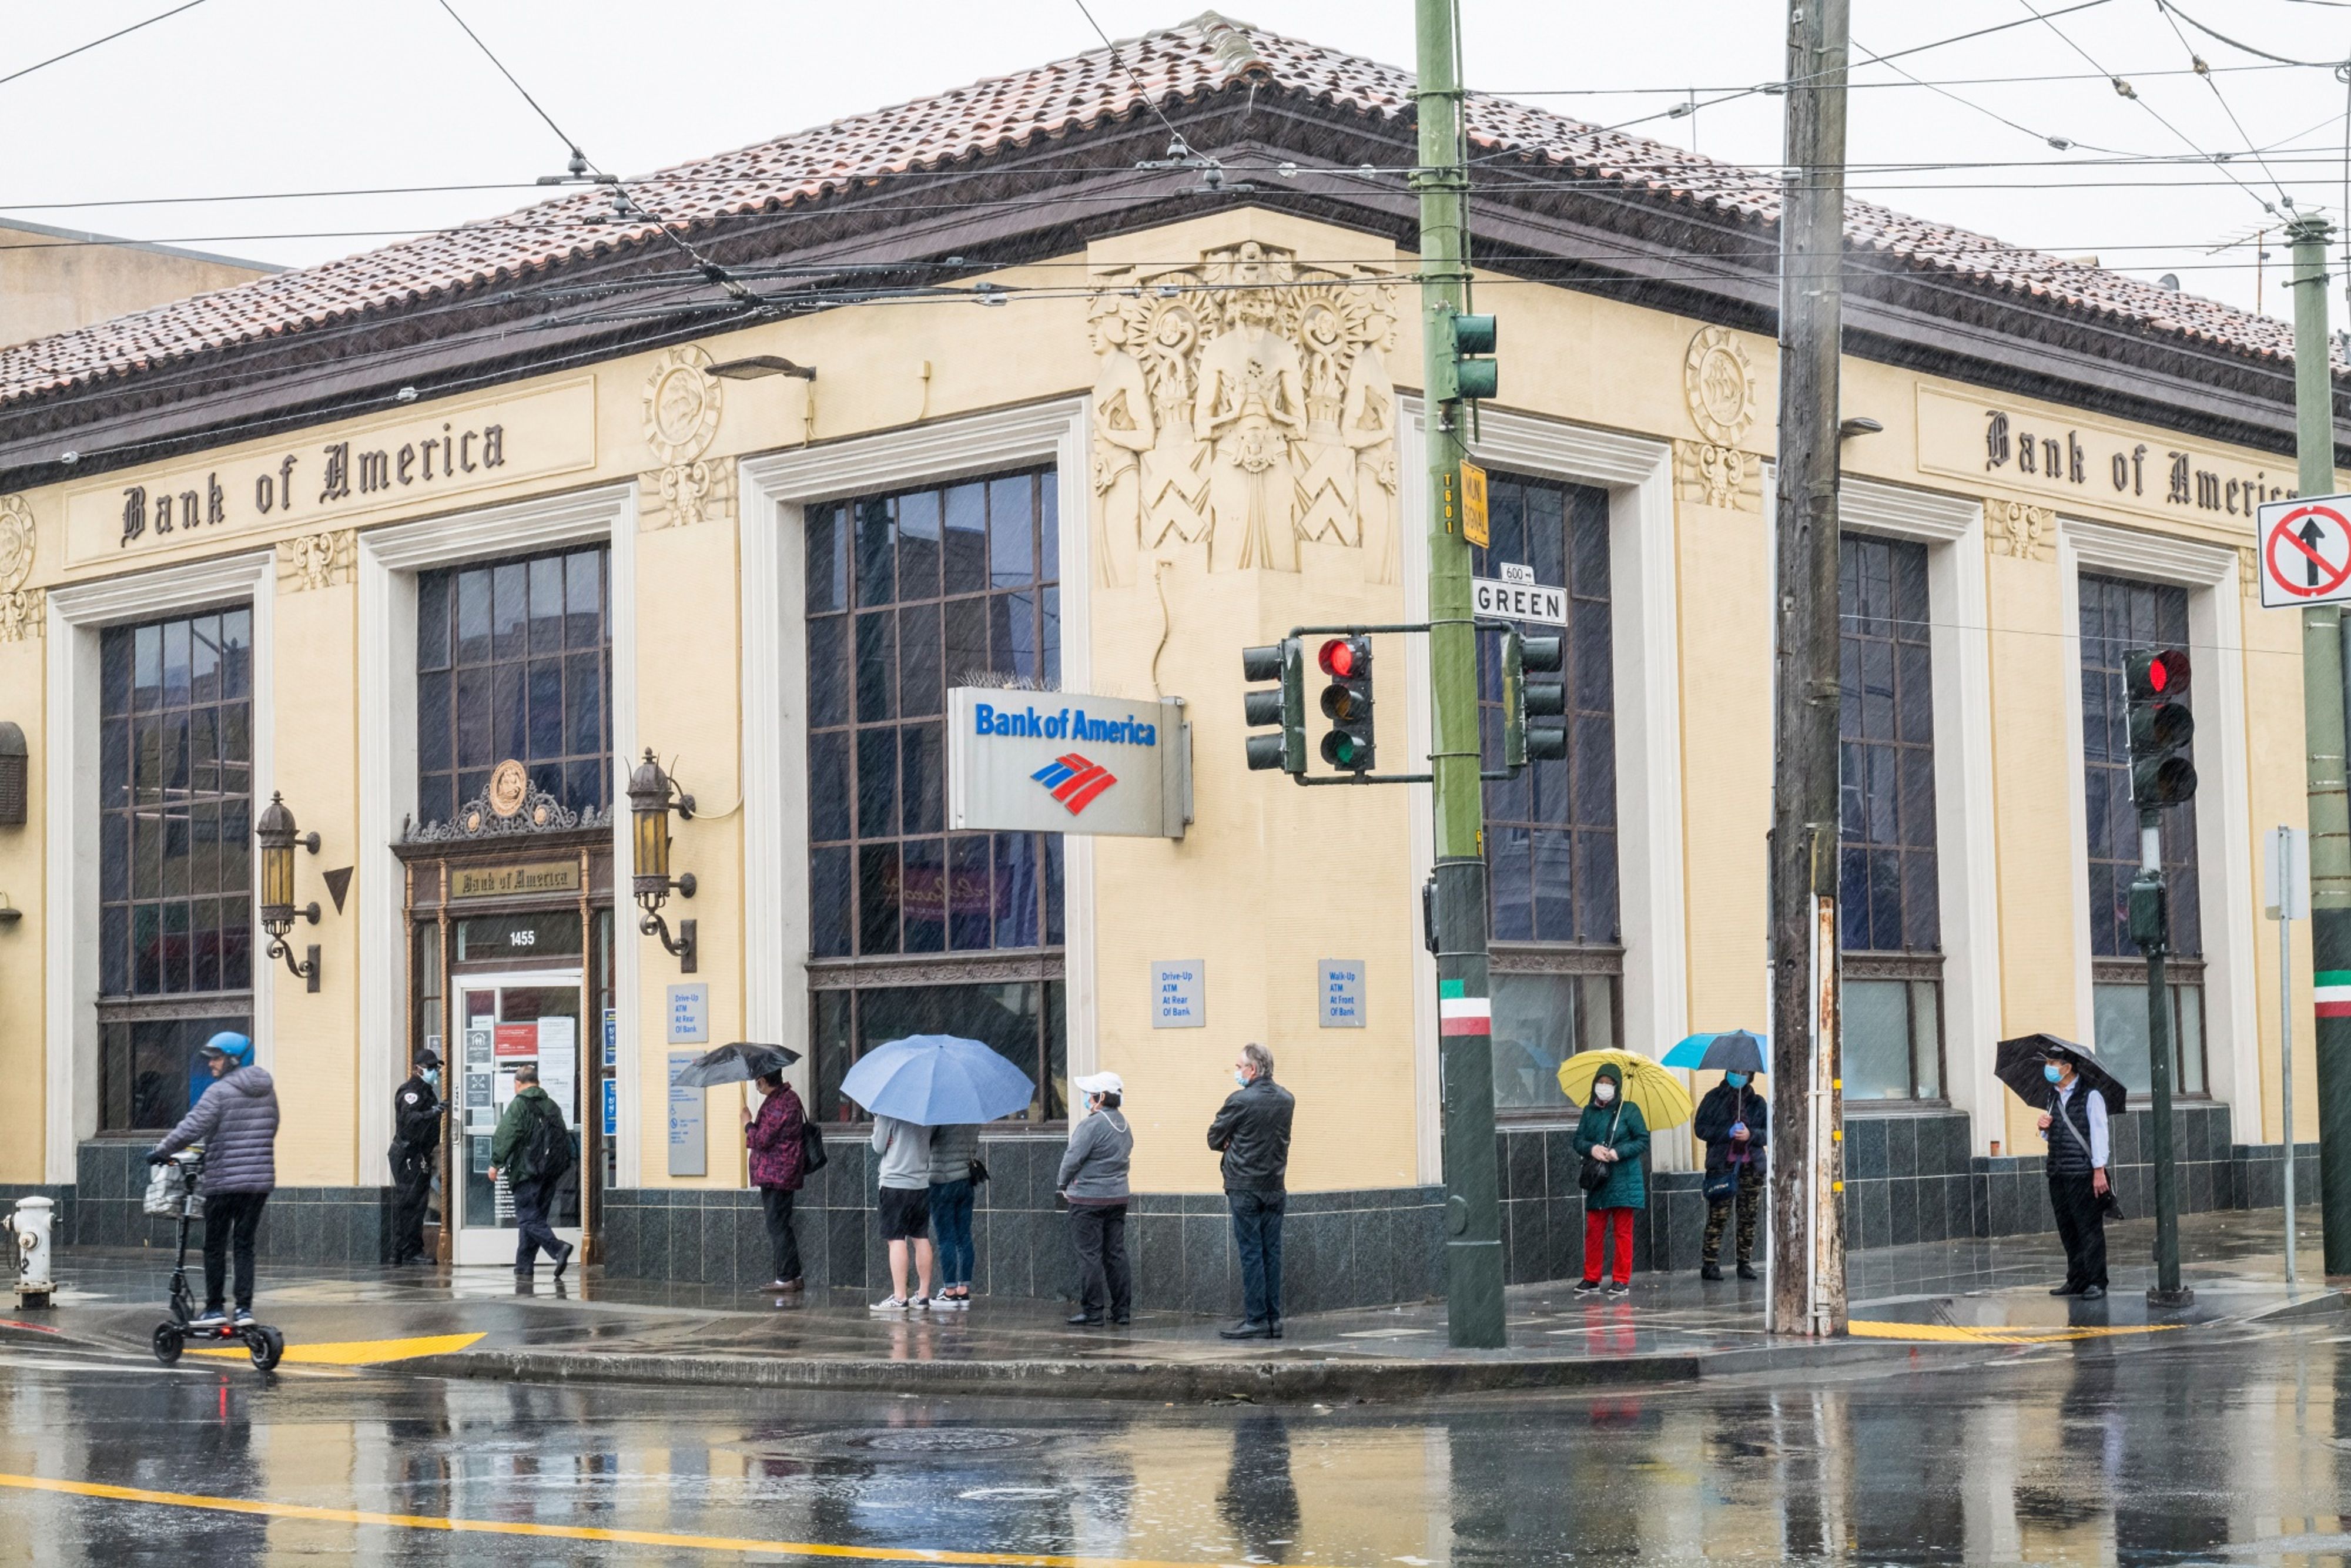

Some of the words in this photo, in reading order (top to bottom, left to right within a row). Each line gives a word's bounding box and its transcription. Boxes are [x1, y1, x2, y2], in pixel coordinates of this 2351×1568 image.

[1986, 410, 2085, 484] Bank
[2112, 444, 2147, 496] of
[2167, 451, 2298, 517] Ameri
[121, 472, 225, 547] Bank
[255, 454, 297, 514] of
[319, 423, 505, 503] America
[1506, 567, 1523, 580] 600
[1478, 586, 1559, 617] GREEN
[975, 703, 1042, 738] Bank
[1044, 708, 1069, 739] of
[1072, 709, 1156, 747] America
[463, 872, 495, 894] Bank
[500, 873, 512, 889] of
[514, 869, 568, 889] America
[510, 930, 535, 947] 1455
[1162, 971, 1193, 982] Drive-Up
[1329, 971, 1355, 982] Walk-Up
[1162, 984, 1177, 993] ATM
[1330, 983, 1343, 992] ATM
[675, 994, 699, 1003] Drive-Up
[1162, 996, 1170, 1004] At
[1172, 996, 1188, 1004] Rear
[1330, 996, 1337, 1004] At
[1339, 996, 1354, 1004] Front
[1163, 1007, 1171, 1016] Of
[1173, 1007, 1191, 1016] Bank
[1330, 1007, 1338, 1016] Of
[1339, 1007, 1355, 1016] Bank
[675, 1025, 682, 1033] Of
